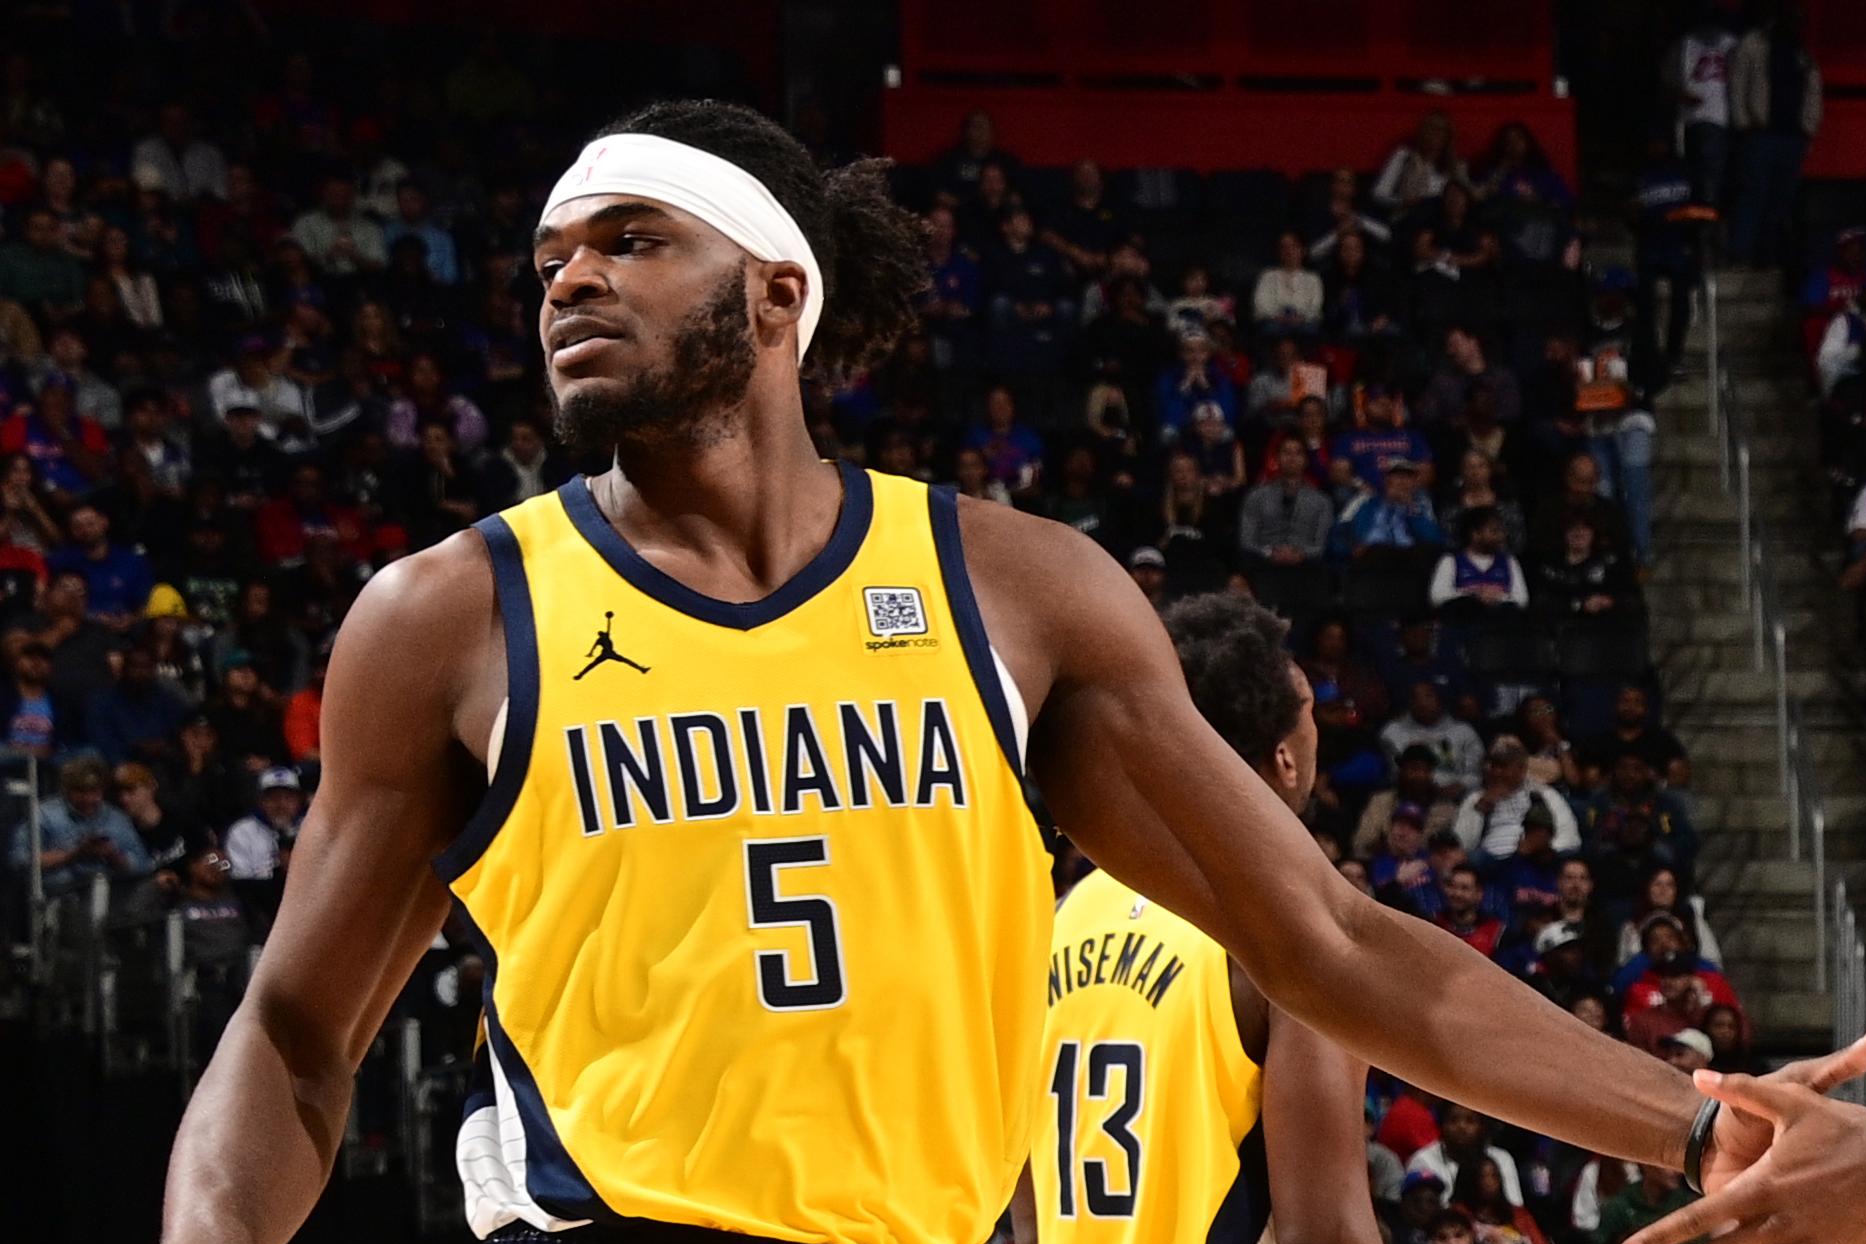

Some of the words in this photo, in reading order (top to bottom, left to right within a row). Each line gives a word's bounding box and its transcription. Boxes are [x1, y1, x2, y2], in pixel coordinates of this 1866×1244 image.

[865, 638, 939, 652] spokenote
[564, 697, 968, 838] INDIANA
[743, 835, 848, 1012] 5
[1050, 1039, 1146, 1221] 13
